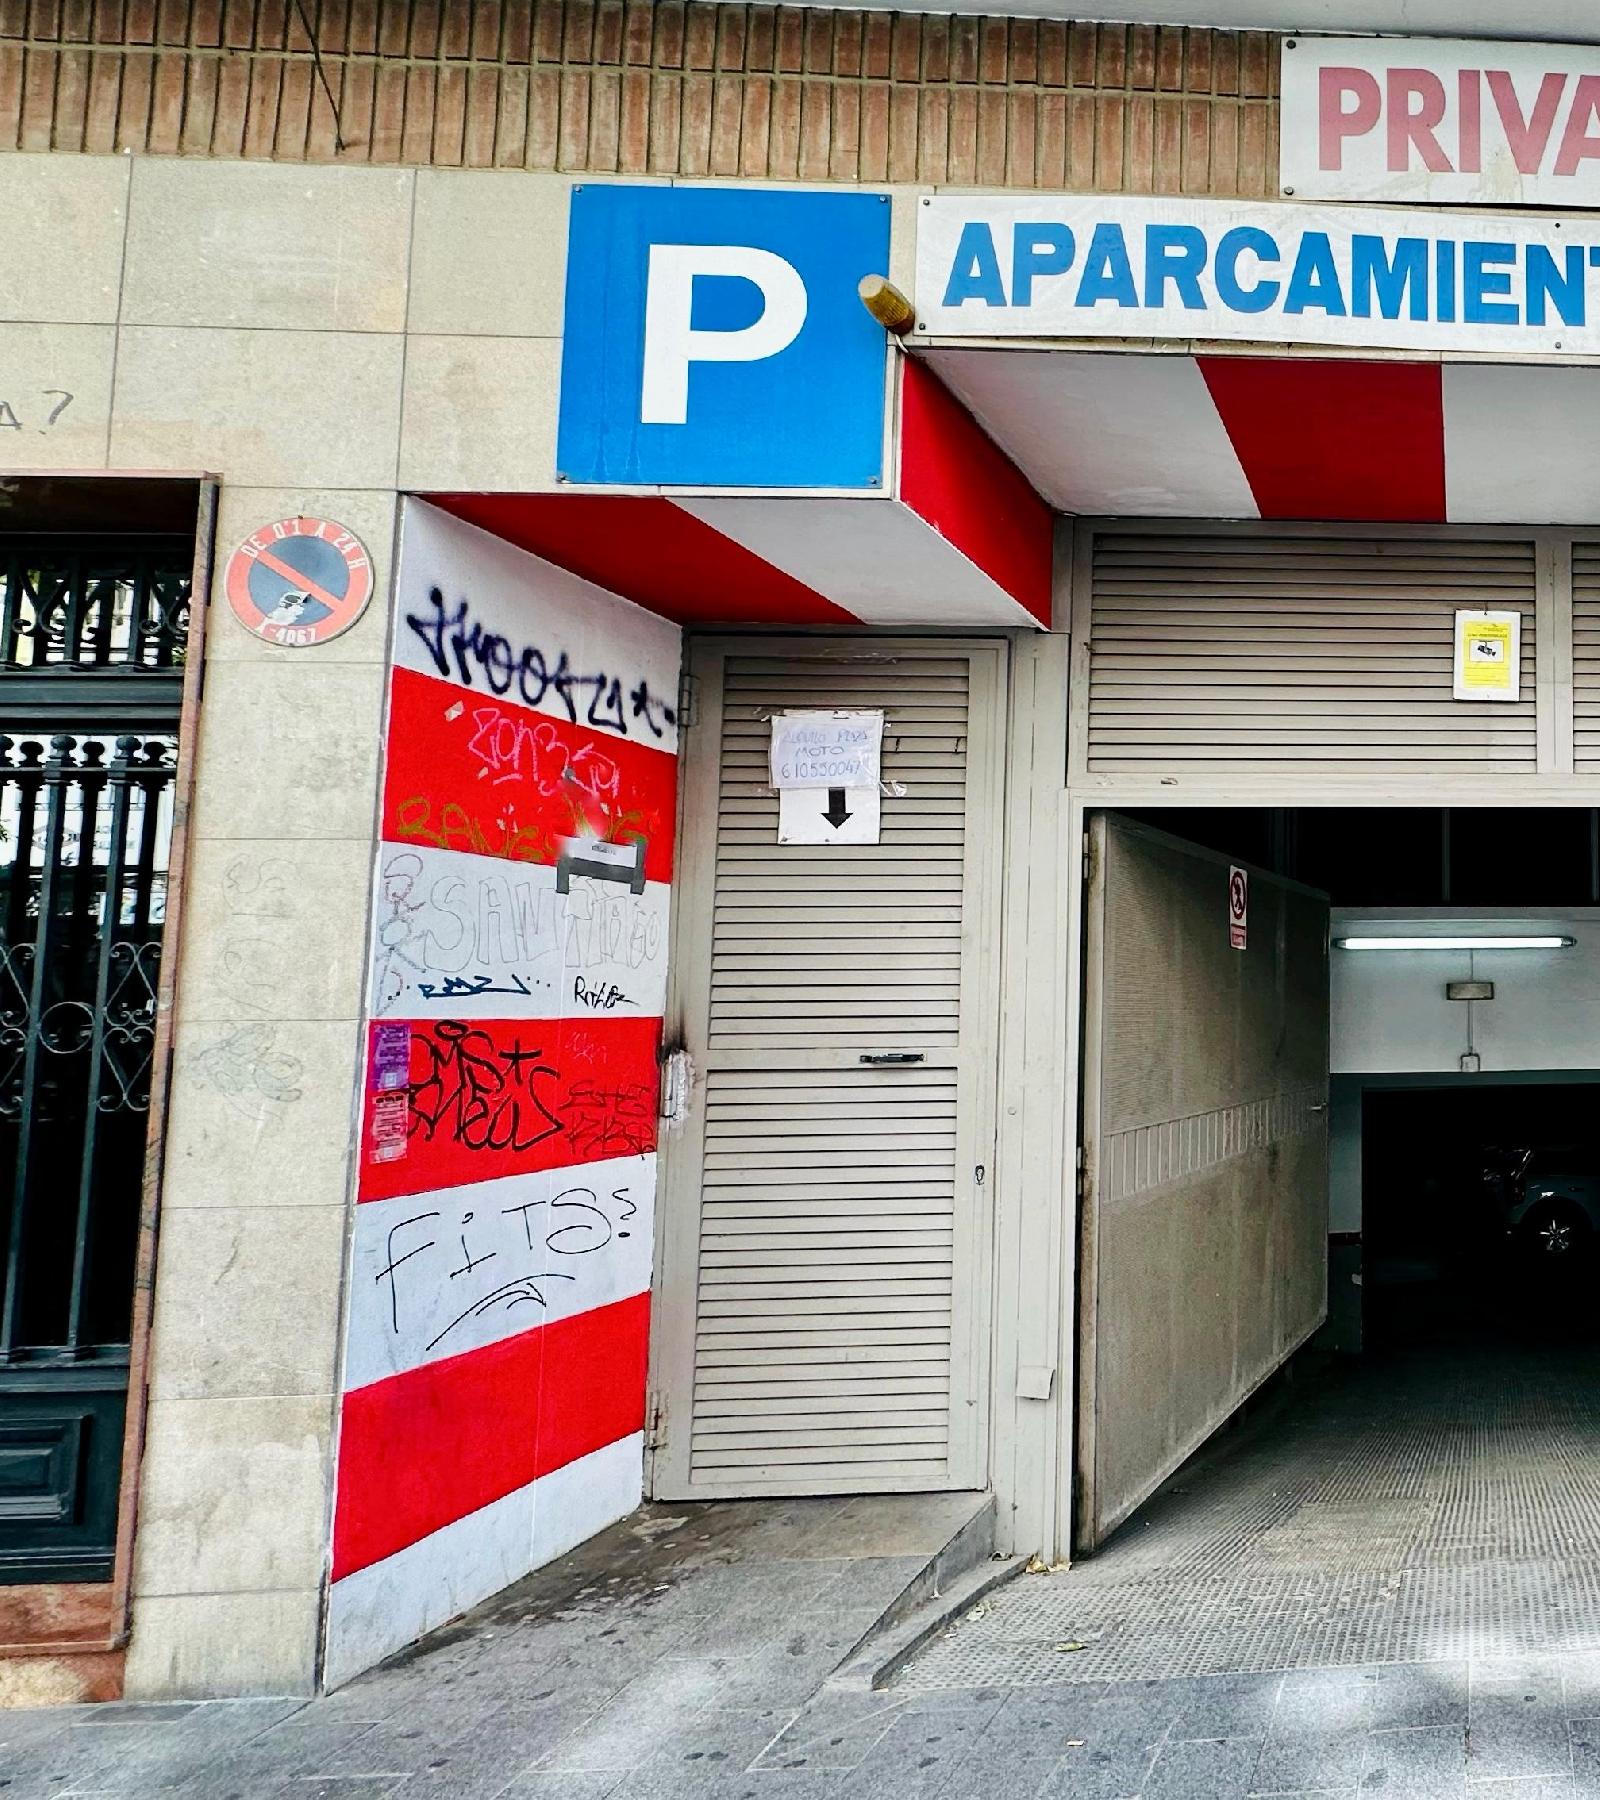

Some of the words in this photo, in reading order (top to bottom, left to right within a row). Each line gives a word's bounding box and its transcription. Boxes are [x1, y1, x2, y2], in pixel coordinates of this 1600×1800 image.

[640, 243, 808, 425] P
[240, 534, 268, 560] DE
[795, 745, 845, 757] MOTO
